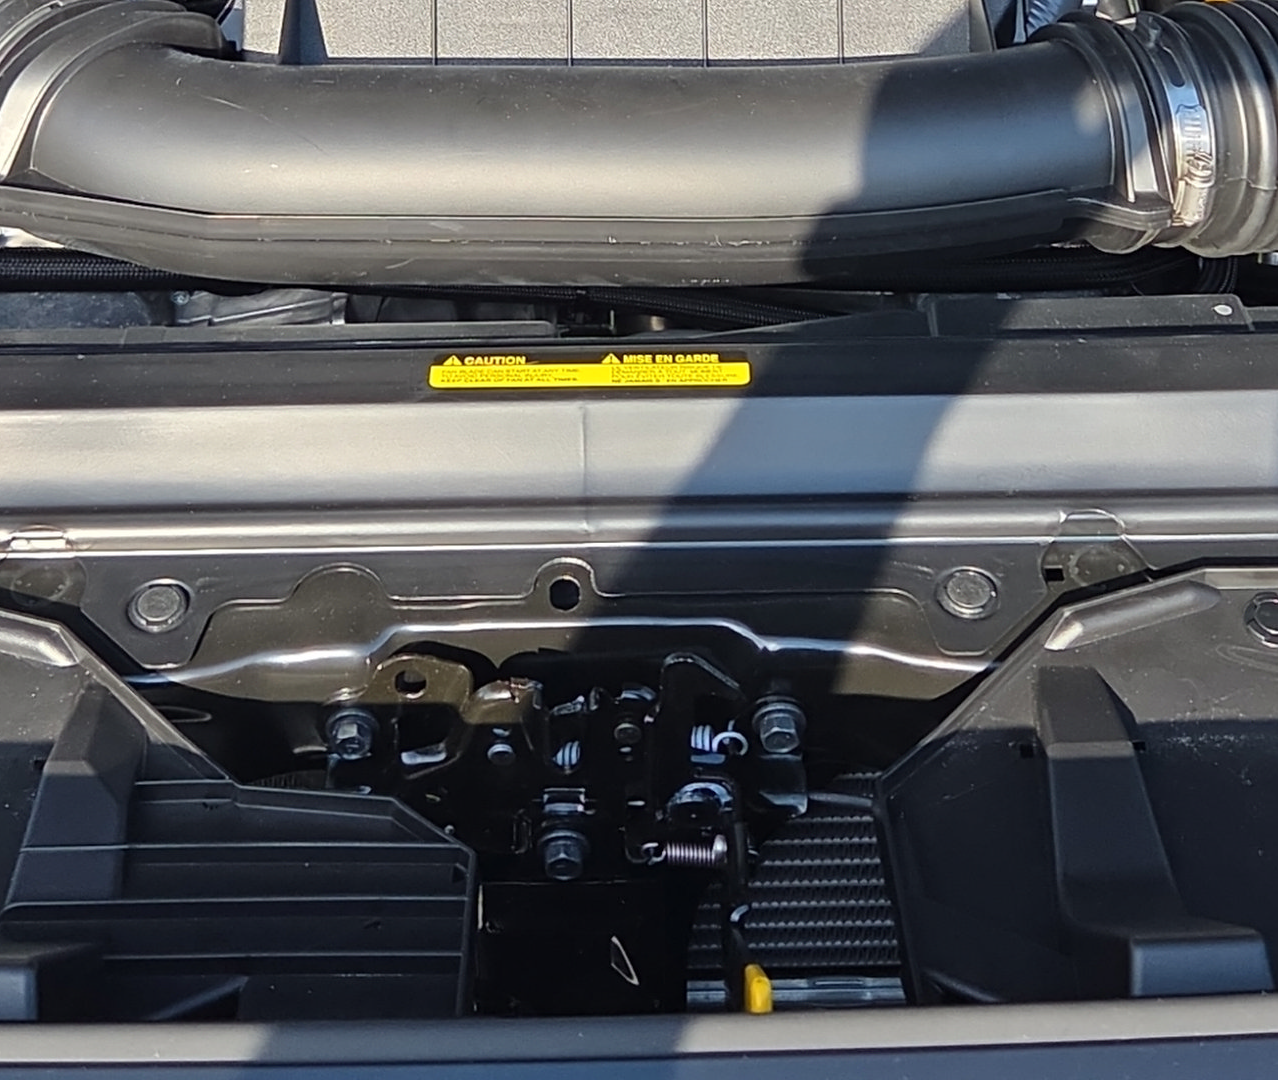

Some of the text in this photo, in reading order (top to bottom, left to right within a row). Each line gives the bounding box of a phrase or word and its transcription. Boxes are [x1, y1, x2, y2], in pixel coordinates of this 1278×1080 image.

[463, 355, 527, 366] CAUTION
[622, 353, 720, 364] MISE EN GARDE
